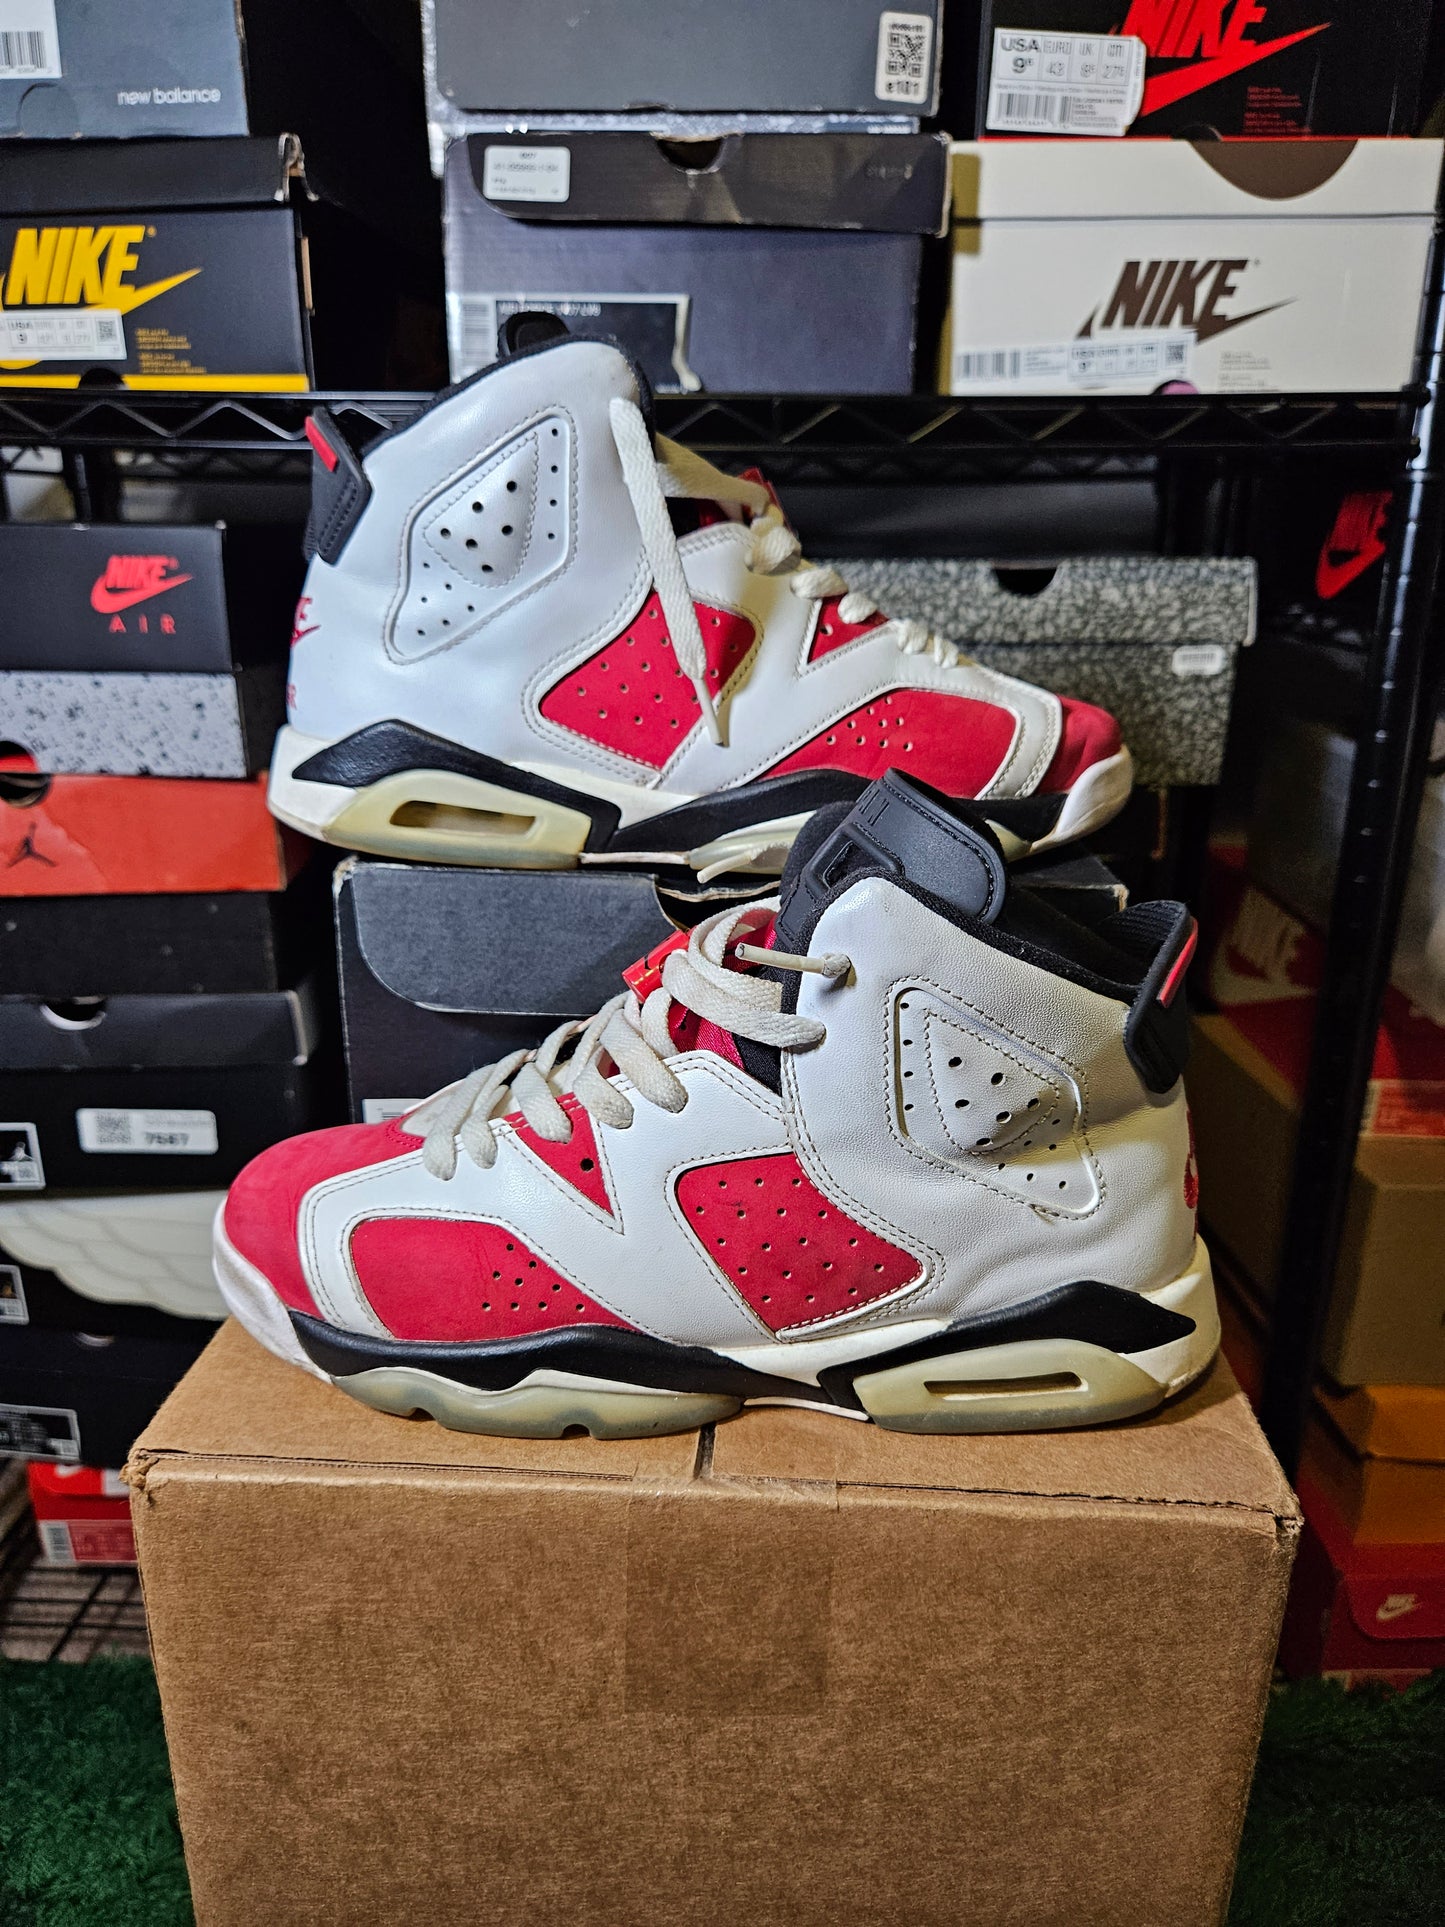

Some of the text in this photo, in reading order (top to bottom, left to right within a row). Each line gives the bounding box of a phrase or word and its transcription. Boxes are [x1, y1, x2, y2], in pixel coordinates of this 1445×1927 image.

[1001, 38, 1041, 52] USA
[117, 87, 221, 105] new balance
[6, 225, 146, 304] NIKE
[1101, 259, 1249, 327] NIKE
[105, 554, 169, 589] NIKE
[109, 613, 176, 634] AIR
